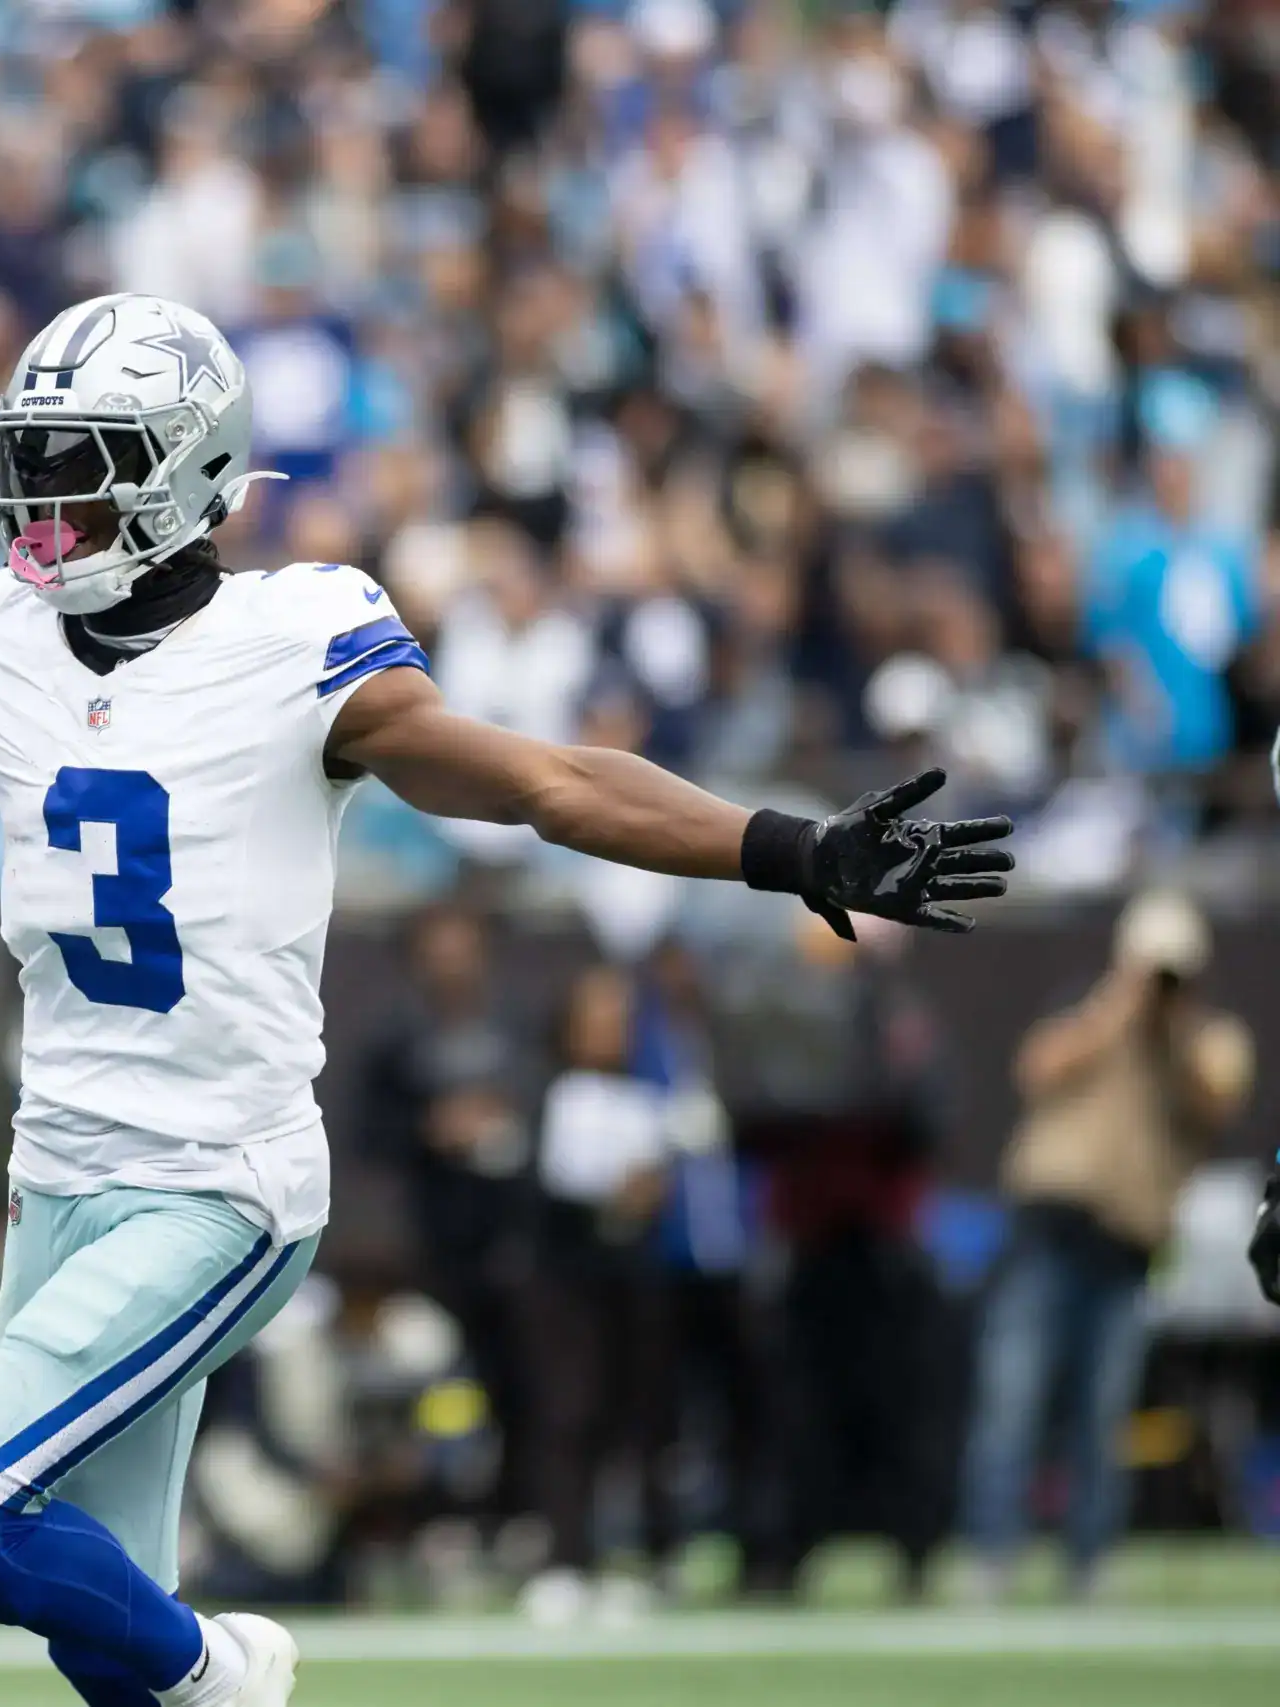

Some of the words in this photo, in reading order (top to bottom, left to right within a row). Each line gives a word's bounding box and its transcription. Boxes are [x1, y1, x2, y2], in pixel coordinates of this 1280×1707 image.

[21, 396, 64, 407] COWBOYS
[89, 711, 109, 726] NFL
[43, 766, 186, 1014] 3
